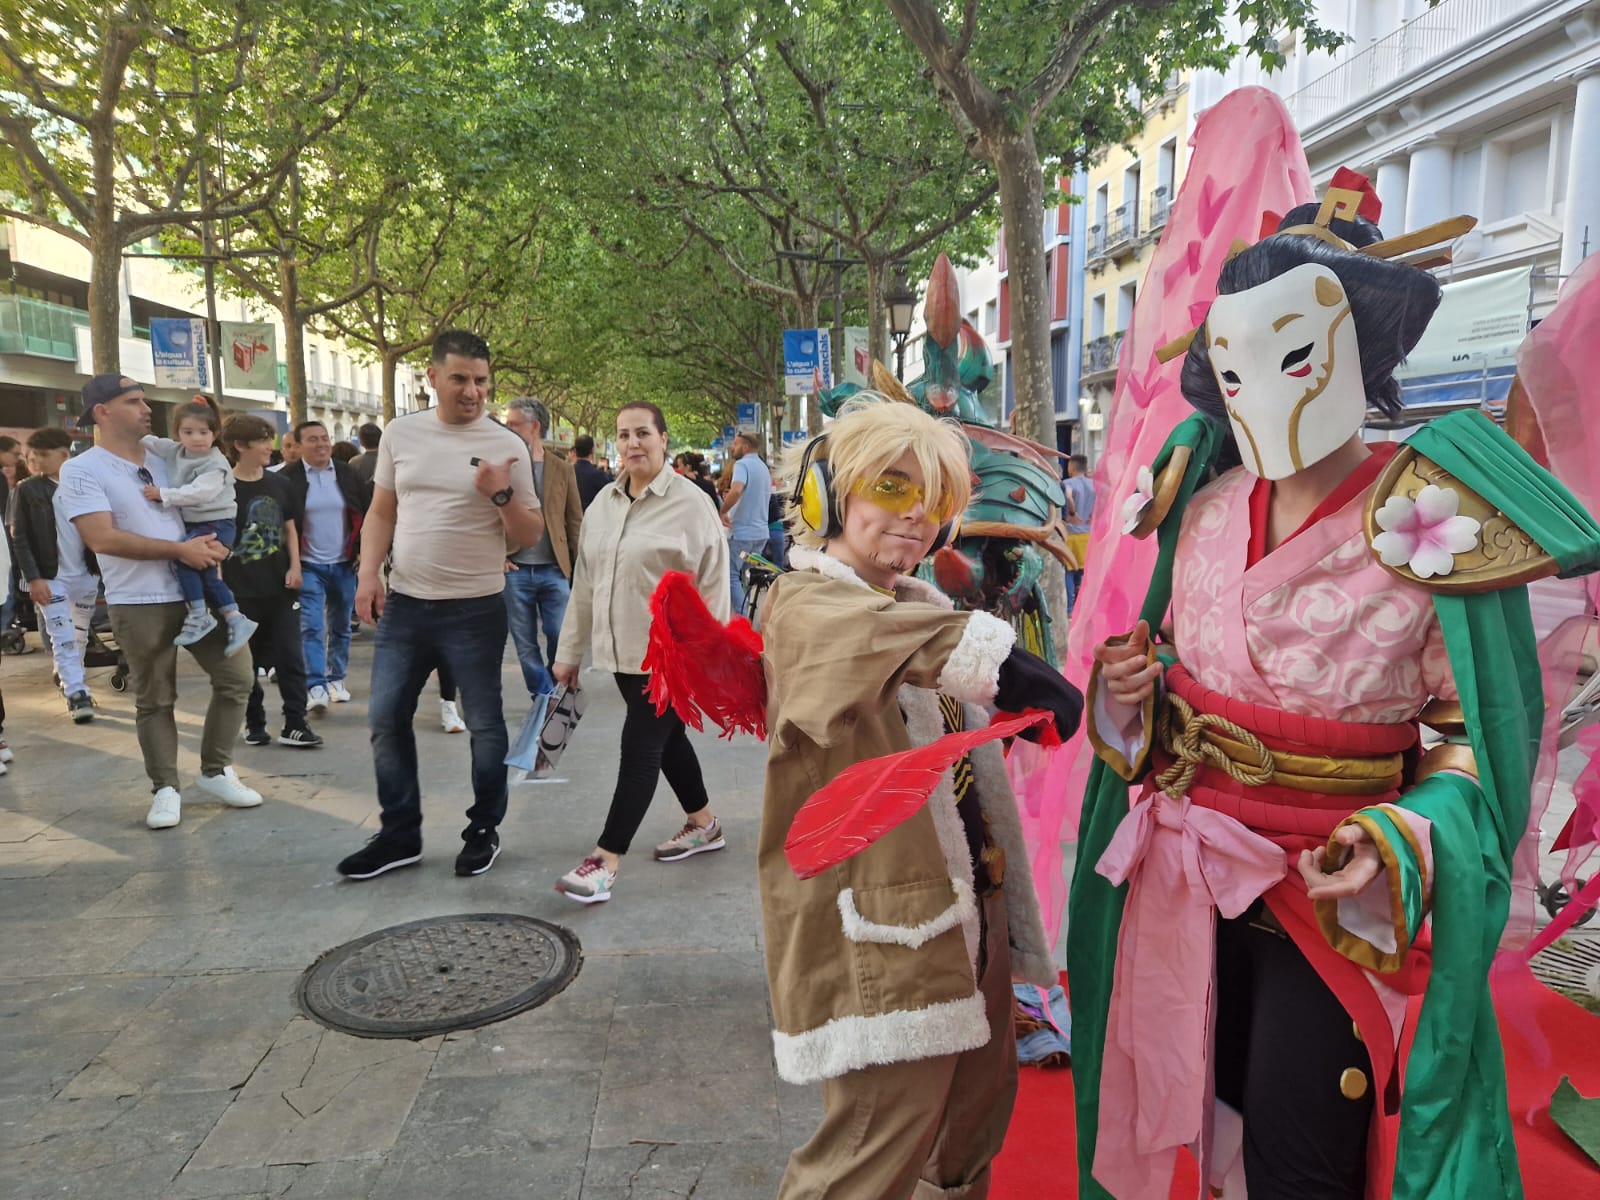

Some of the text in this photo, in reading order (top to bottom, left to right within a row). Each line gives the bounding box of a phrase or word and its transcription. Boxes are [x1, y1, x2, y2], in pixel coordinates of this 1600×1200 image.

[155, 352, 182, 361] L'aigua
[194, 324, 207, 386] essencials
[819, 334, 830, 386] ssencials
